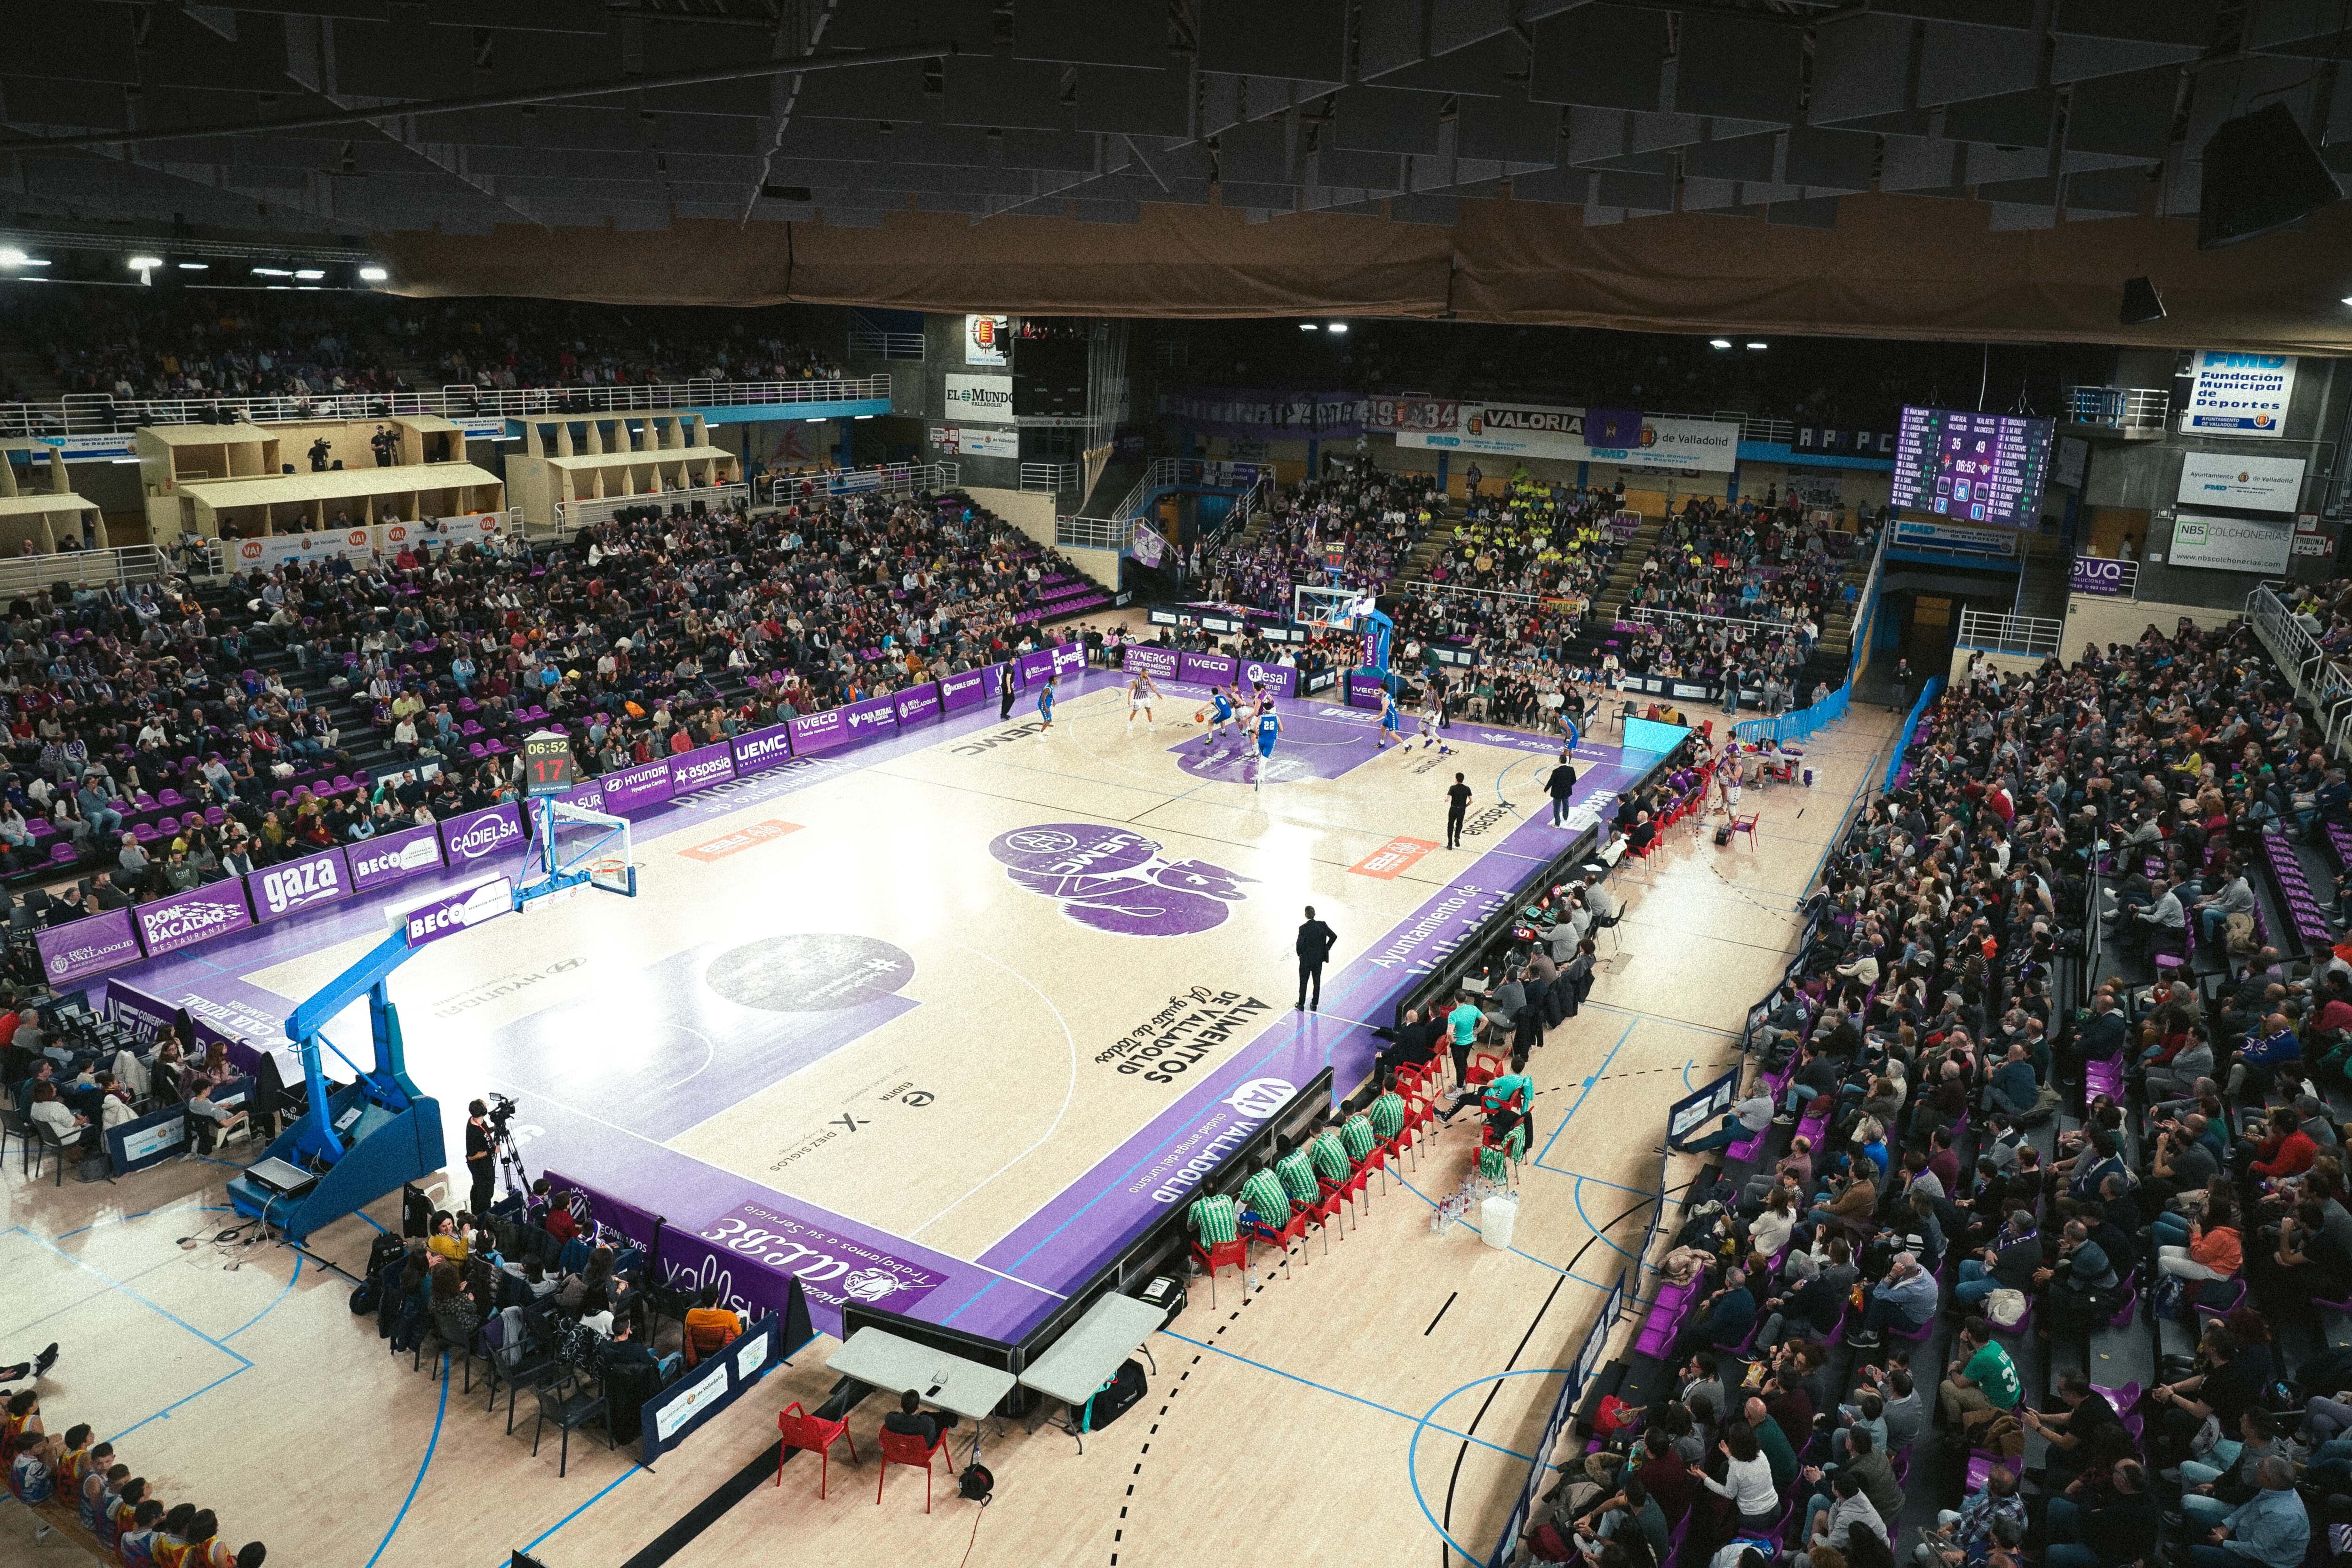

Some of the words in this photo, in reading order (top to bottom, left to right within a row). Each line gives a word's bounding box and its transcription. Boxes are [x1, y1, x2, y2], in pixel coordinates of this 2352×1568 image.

[2201, 372, 2283, 382] Fundación
[2200, 381, 2282, 391] Municipal
[947, 390, 960, 400] EL
[2196, 399, 2280, 409] Deportes
[1486, 410, 1581, 433] VALORIA
[1974, 426, 1994, 434] BALONCESTO
[1663, 433, 1675, 442] de
[1678, 434, 1728, 446] Valladolid
[1952, 438, 1961, 450] 35
[1976, 441, 1986, 453] 49
[1956, 460, 1976, 474] 06:52
[2191, 471, 2233, 480] Ayuntamiento
[1941, 501, 1944, 510] 2
[1975, 507, 1978, 517] 1
[1997, 508, 2010, 517] SUÁREZ
[351, 534, 364, 543] VA!
[2181, 525, 2204, 535] NBS
[2209, 527, 2289, 541] COLCHONERÍAS
[2295, 537, 2324, 545] TRIBUNA
[244, 546, 260, 556] VA!
[1328, 555, 1342, 566] 17
[2177, 553, 2281, 568] www.nbscolchonerias.com
[1053, 650, 1084, 667] HORSE
[1151, 662, 1171, 671] MÉDICO
[1188, 658, 1228, 671] IVECO
[951, 682, 966, 691] MOBILE
[966, 678, 980, 687] GROUP
[908, 697, 937, 710] VALLADOLID
[861, 712, 874, 720] CAJA
[875, 707, 893, 716] RURAL
[797, 713, 838, 731] IVECO
[1264, 721, 1275, 730] 22
[737, 734, 787, 761] UEMC
[951, 723, 1054, 756] UEMC
[528, 741, 567, 755] 06:52
[739, 750, 787, 767] UNIVERSIDAD
[534, 759, 564, 782] 17
[690, 756, 731, 778] aspasia
[624, 765, 668, 786] HYUNDAI
[631, 781, 653, 794] Hyupersa
[653, 779, 666, 788] Centro
[578, 795, 602, 809] SUR
[1462, 808, 1508, 836] aspasia
[451, 820, 518, 852] CADIELSA
[1049, 834, 1144, 875] UEMC
[358, 851, 401, 877] BECO
[263, 859, 338, 913] gaza
[143, 906, 184, 929] DON
[410, 903, 465, 939] BECO
[148, 908, 224, 944] BACALAO
[1368, 897, 1468, 969] Ayuntamiento
[1454, 884, 1482, 897] de
[1518, 929, 1530, 937] 5
[153, 923, 228, 953] RESTAURANTE
[69, 947, 95, 958] REAL
[70, 940, 134, 963] VALLADOLID
[1210, 991, 1241, 1006] DE
[178, 994, 229, 1020] RURAL
[1152, 996, 1188, 1029] gusto
[1132, 1024, 1156, 1036] de
[1117, 1009, 1225, 1075] VALLADOLID
[1144, 996, 1272, 1083] ALIMENTOS
[1095, 1037, 1142, 1064] todos
[879, 1082, 914, 1101] EUDITA
[1237, 1084, 1291, 1112] VA!
[1199, 1113, 1226, 1136] ciudad
[810, 1131, 837, 1147] DIEZ
[1175, 1134, 1203, 1155] amiga
[770, 1147, 811, 1171] SIGLOS
[1152, 1121, 1259, 1203] VALLADOLID
[1163, 1154, 1178, 1167] del
[1129, 1166, 1168, 1194] turismo
[744, 1205, 804, 1234] Servicio
[806, 1229, 823, 1240] su
[840, 1243, 930, 1284] Trabajamos
[660, 1403, 685, 1424] Ayuntamiento
[703, 1373, 723, 1392] Valladolid
